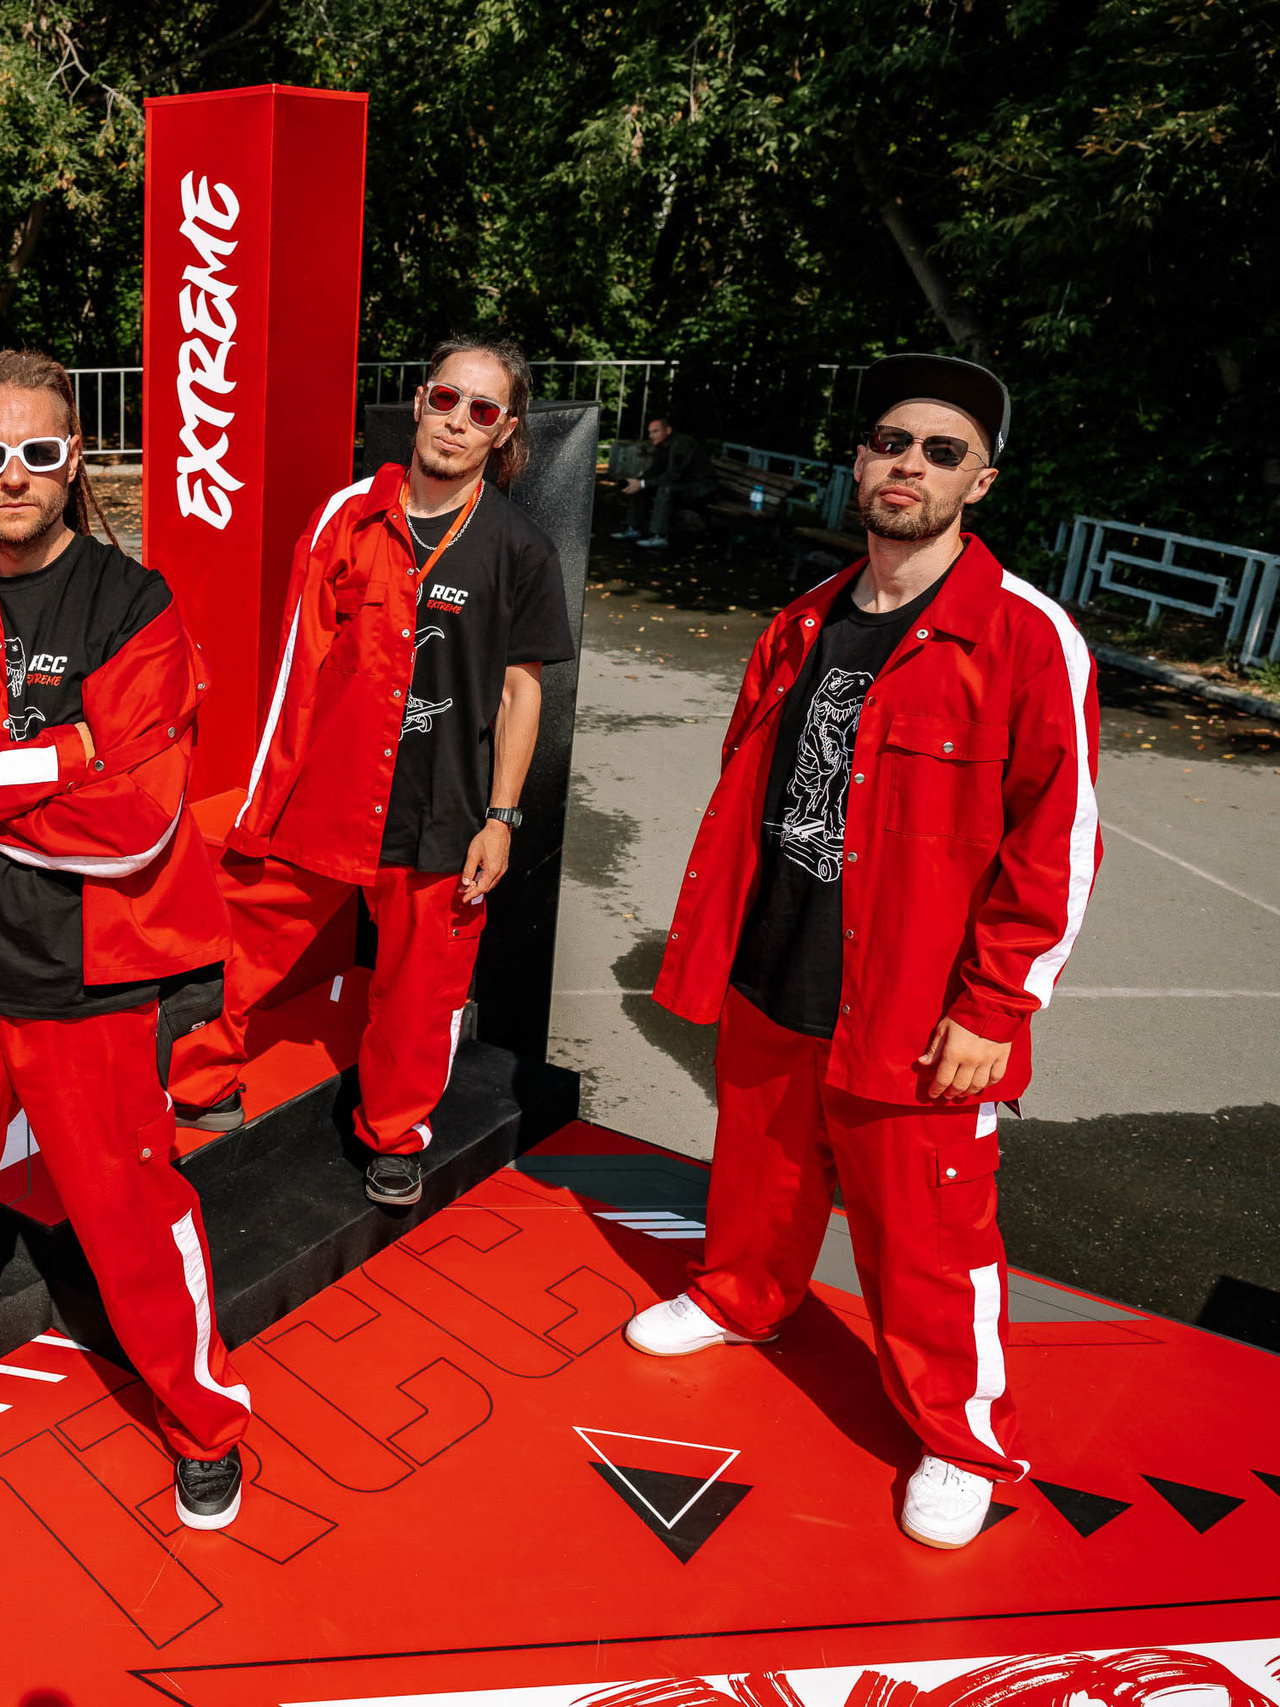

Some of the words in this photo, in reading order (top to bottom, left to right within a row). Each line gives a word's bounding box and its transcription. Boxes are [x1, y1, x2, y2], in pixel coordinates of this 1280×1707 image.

[176, 170, 246, 530] EXTREME
[429, 583, 469, 605] RCC
[426, 599, 463, 615] EXTREME
